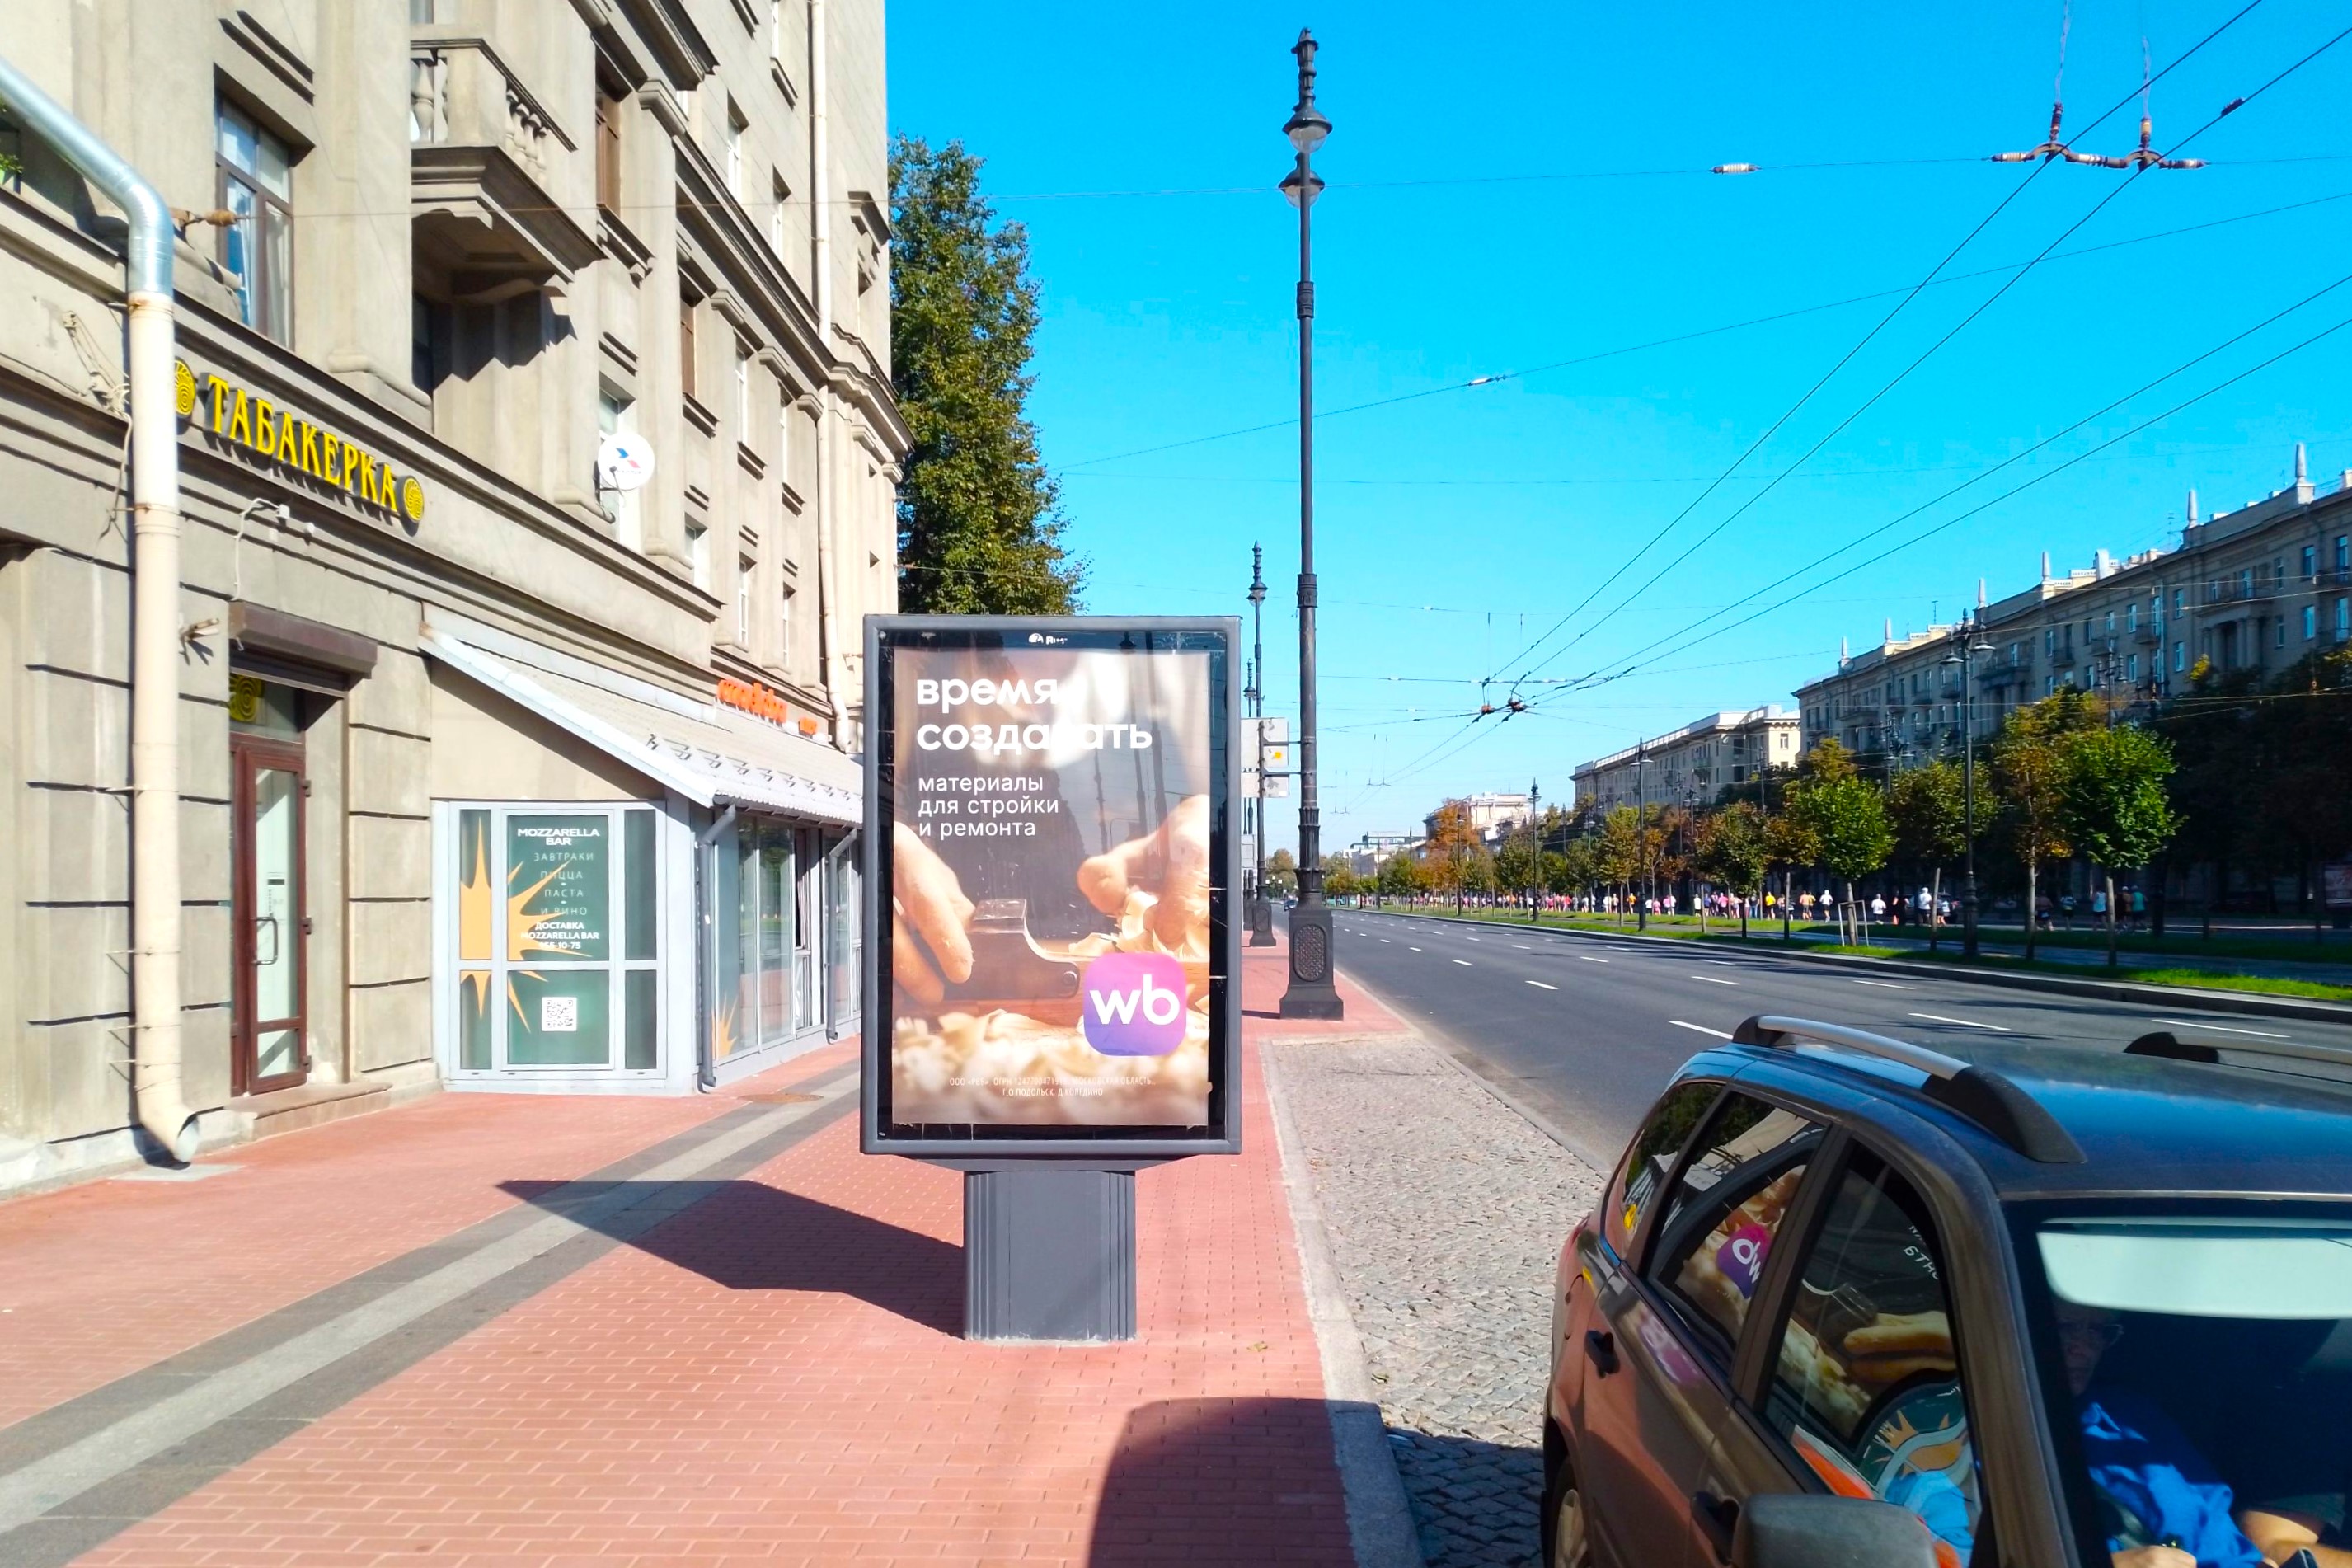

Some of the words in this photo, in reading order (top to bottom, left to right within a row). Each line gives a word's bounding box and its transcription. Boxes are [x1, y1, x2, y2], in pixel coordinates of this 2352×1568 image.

[206, 373, 399, 513] ТАБАКЕРКА
[916, 678, 1059, 714] время
[916, 723, 1153, 756] создаать
[918, 777, 1044, 796] материалы
[918, 800, 959, 818] для
[967, 795, 1059, 818] стройки
[517, 828, 601, 838] MOZZARELLA
[918, 822, 932, 837] и
[940, 821, 1036, 841] ремонта
[545, 837, 573, 846] BAR
[533, 852, 594, 861] ЗАВТРАКИ
[544, 889, 584, 898] ПАСТА
[553, 907, 588, 916] ВИНО
[534, 922, 585, 931] ДОСТАВКА
[580, 932, 600, 940] BAR
[1088, 973, 1181, 1026] wb
[949, 1077, 966, 1087] ООО
